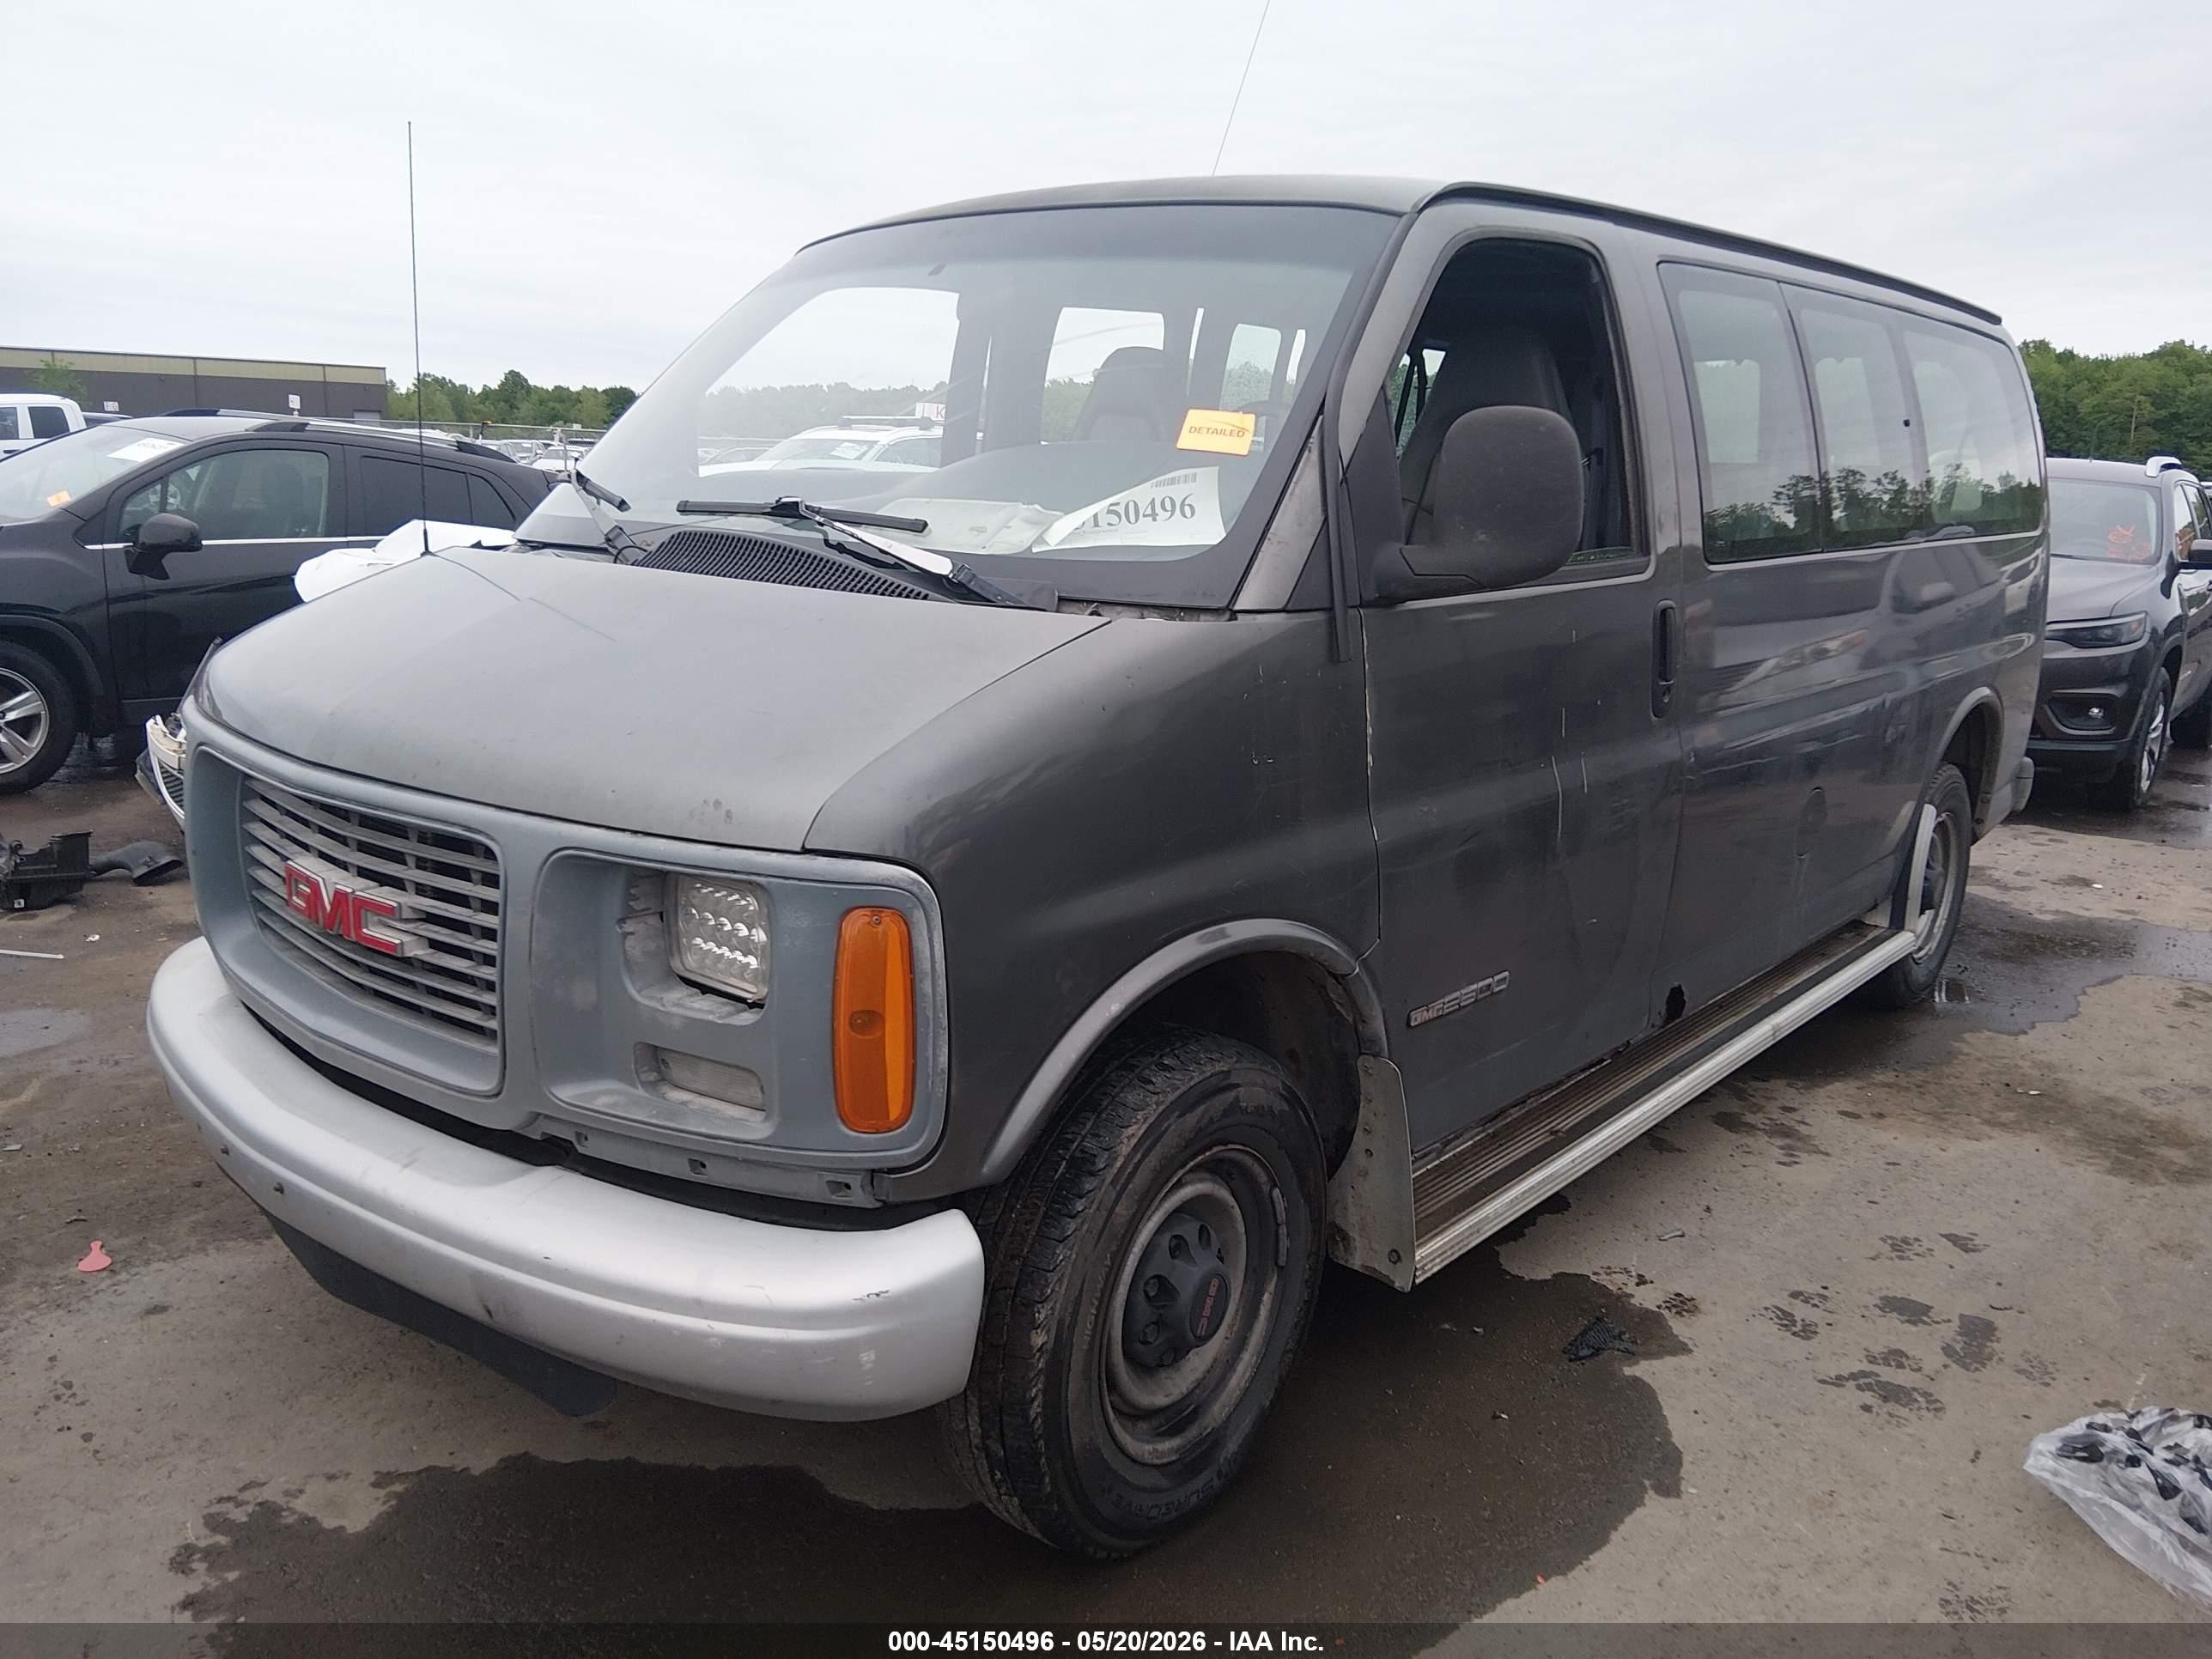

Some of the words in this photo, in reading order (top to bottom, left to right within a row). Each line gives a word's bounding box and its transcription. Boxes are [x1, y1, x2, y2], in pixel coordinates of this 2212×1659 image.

[1188, 425, 1246, 439] DETAILED
[1075, 494, 1196, 532] 150496
[284, 859, 404, 957] GMC
[1196, 1277, 1220, 1335] GMC
